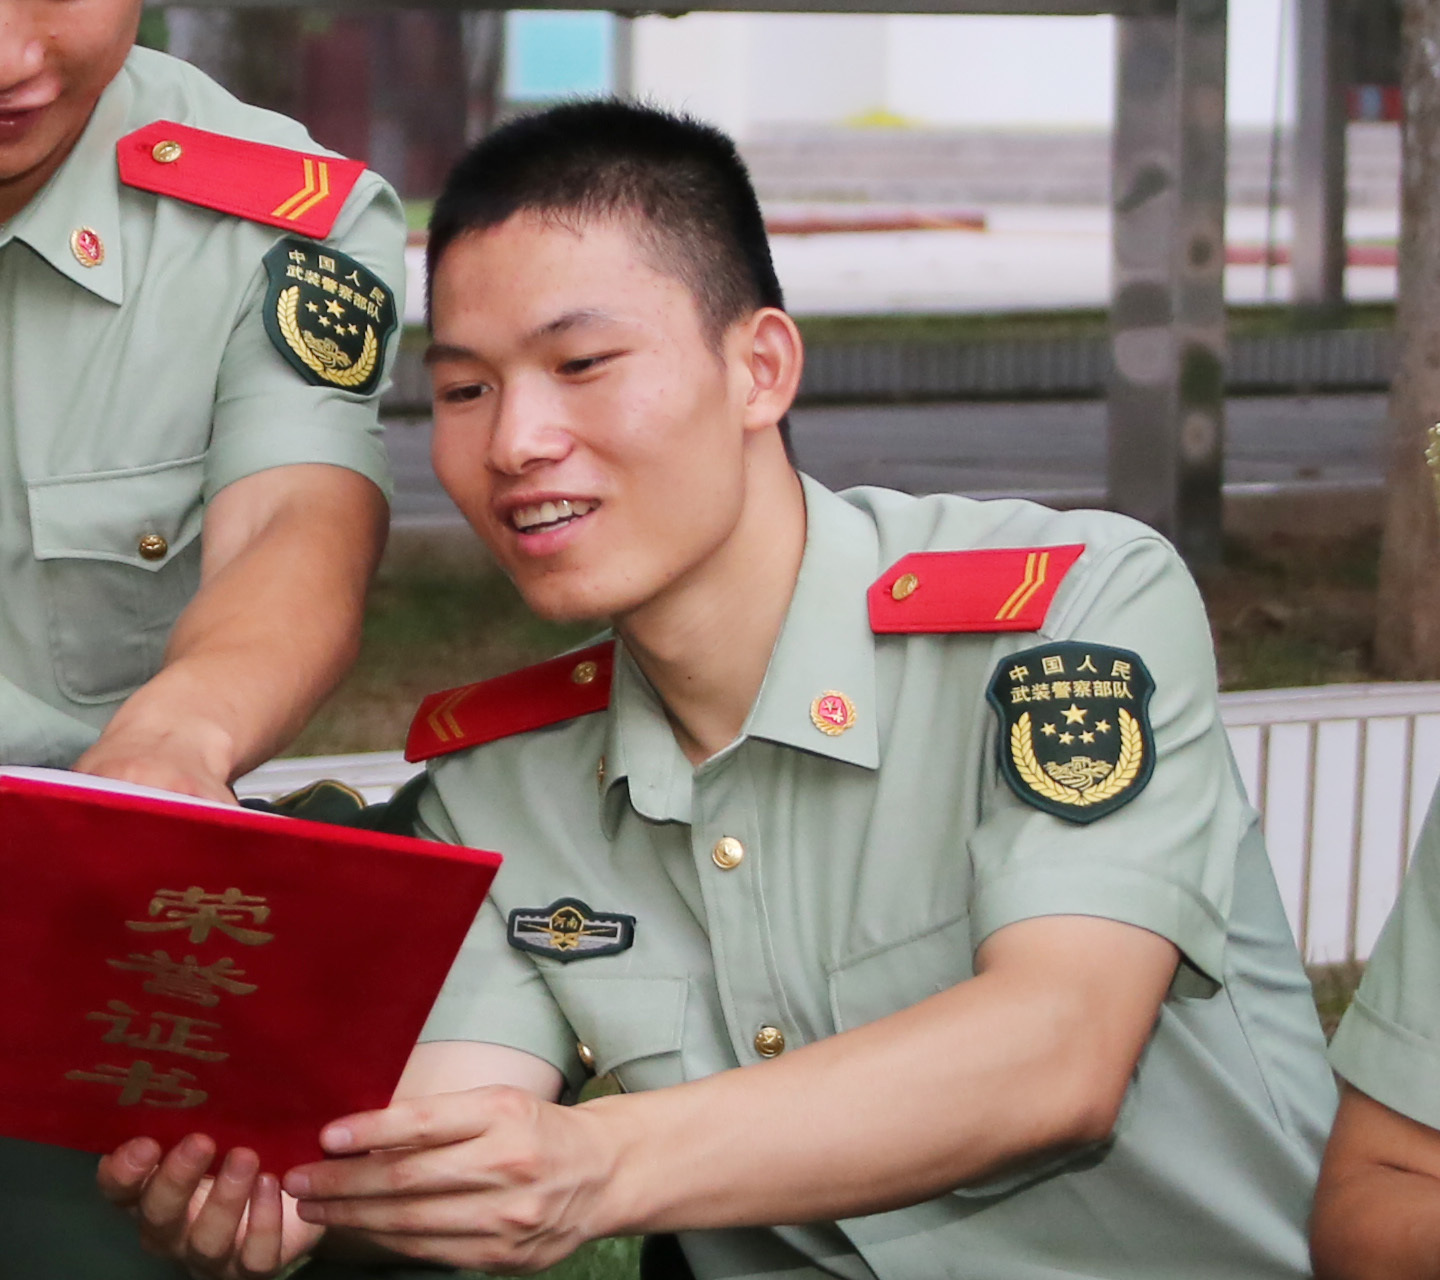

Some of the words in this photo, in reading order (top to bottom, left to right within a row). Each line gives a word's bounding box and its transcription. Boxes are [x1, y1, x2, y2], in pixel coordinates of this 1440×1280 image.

[286, 264, 381, 322] 武装警察部队
[289, 250, 385, 307] 中国人民
[1009, 655, 1132, 683] 中国人民
[1010, 680, 1133, 703] 武装警察部队
[64, 886, 274, 1108] 荣誉证书
